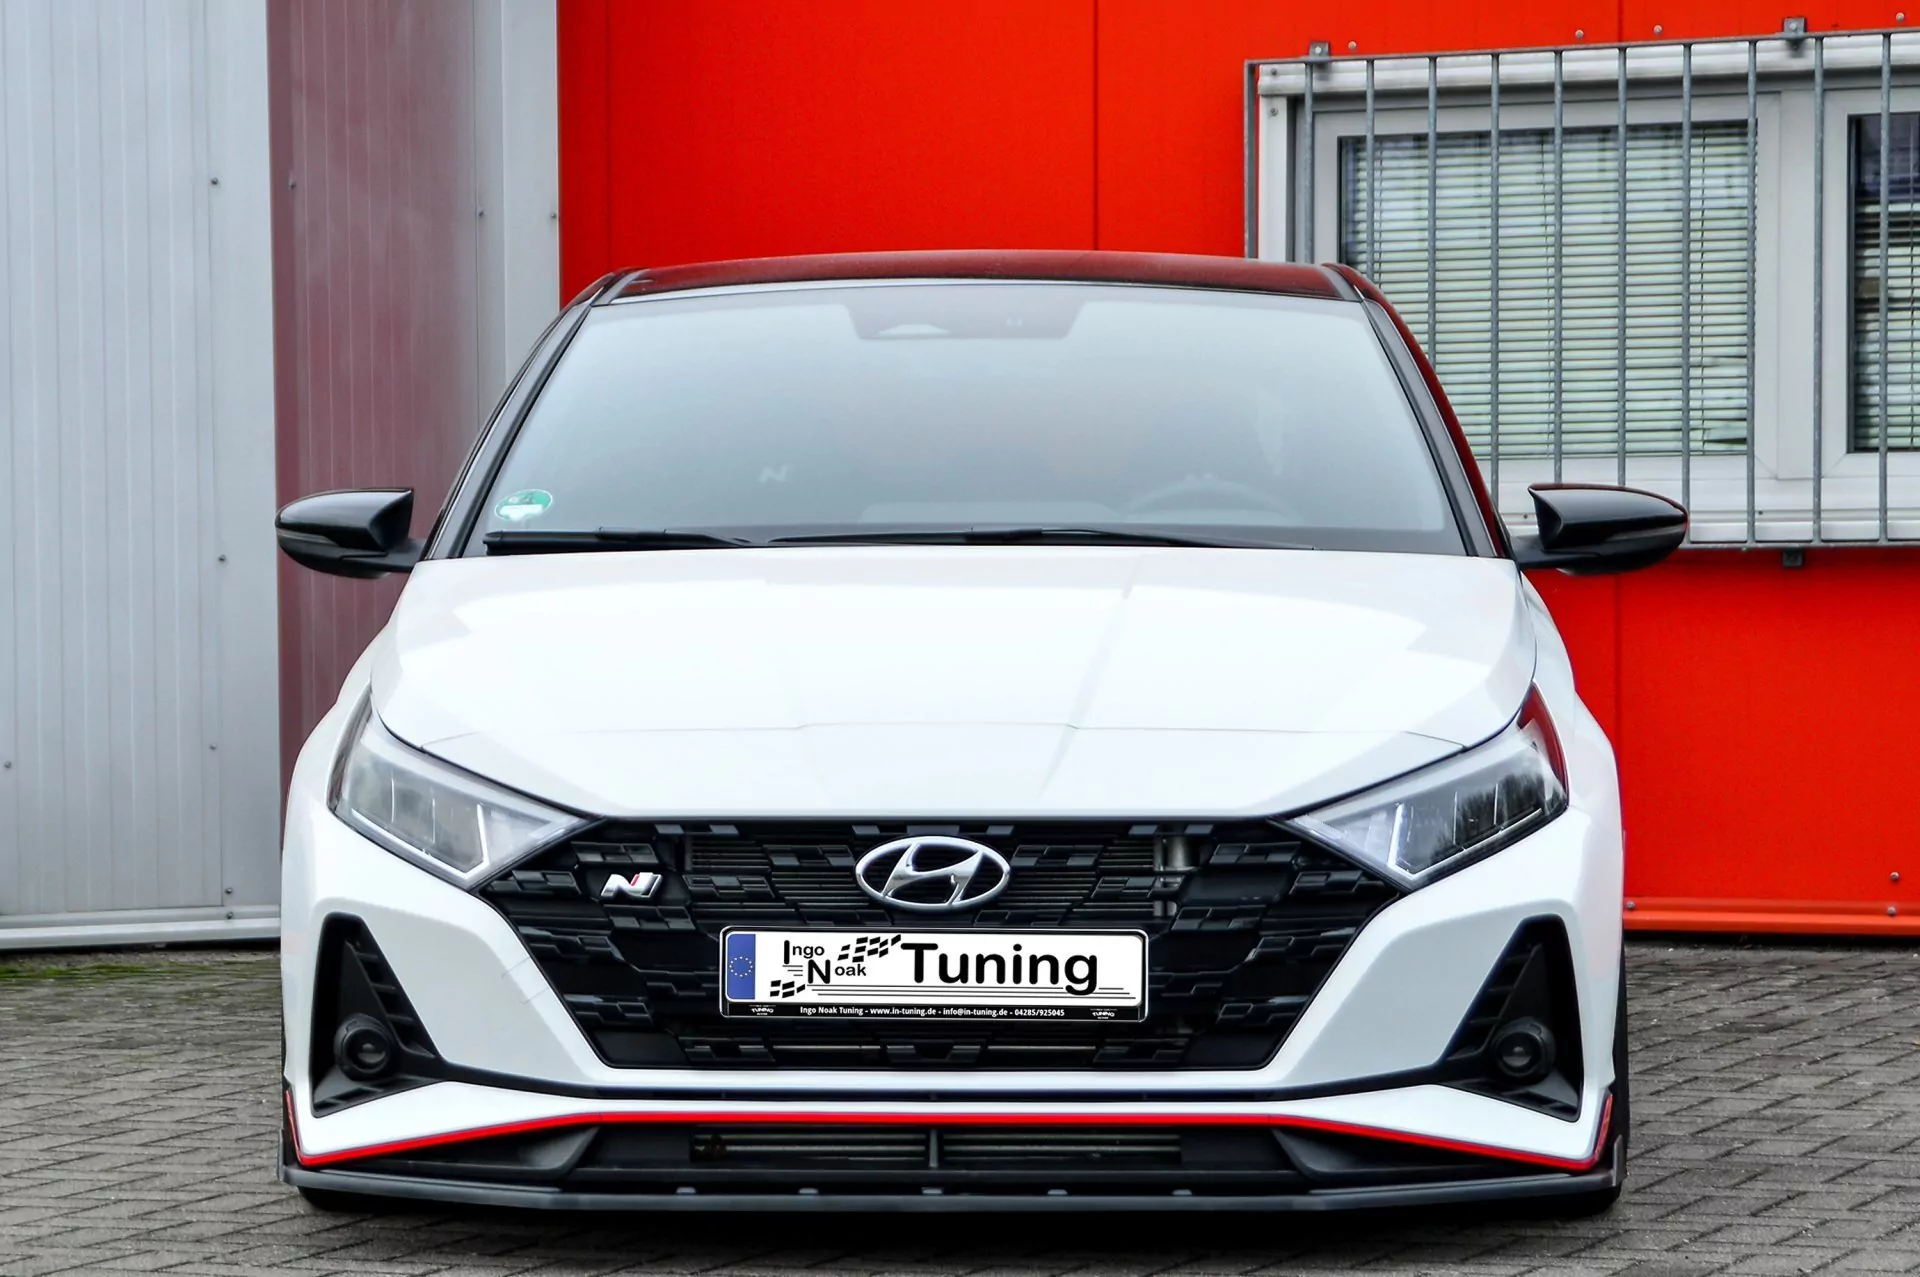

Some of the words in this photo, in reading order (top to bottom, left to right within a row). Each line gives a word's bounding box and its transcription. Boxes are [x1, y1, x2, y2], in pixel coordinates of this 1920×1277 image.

[784, 939, 825, 965] Ingo
[807, 957, 867, 984] Noak
[900, 942, 1098, 996] Tuning
[800, 1006, 816, 1016] Ingo
[818, 1006, 838, 1014] Noak
[839, 1006, 863, 1016] Tuning
[870, 1006, 936, 1017] www.in-tuning.de
[943, 1007, 1008, 1018] info@in-tuning.de
[1014, 1008, 1065, 1017] 04285/925045
